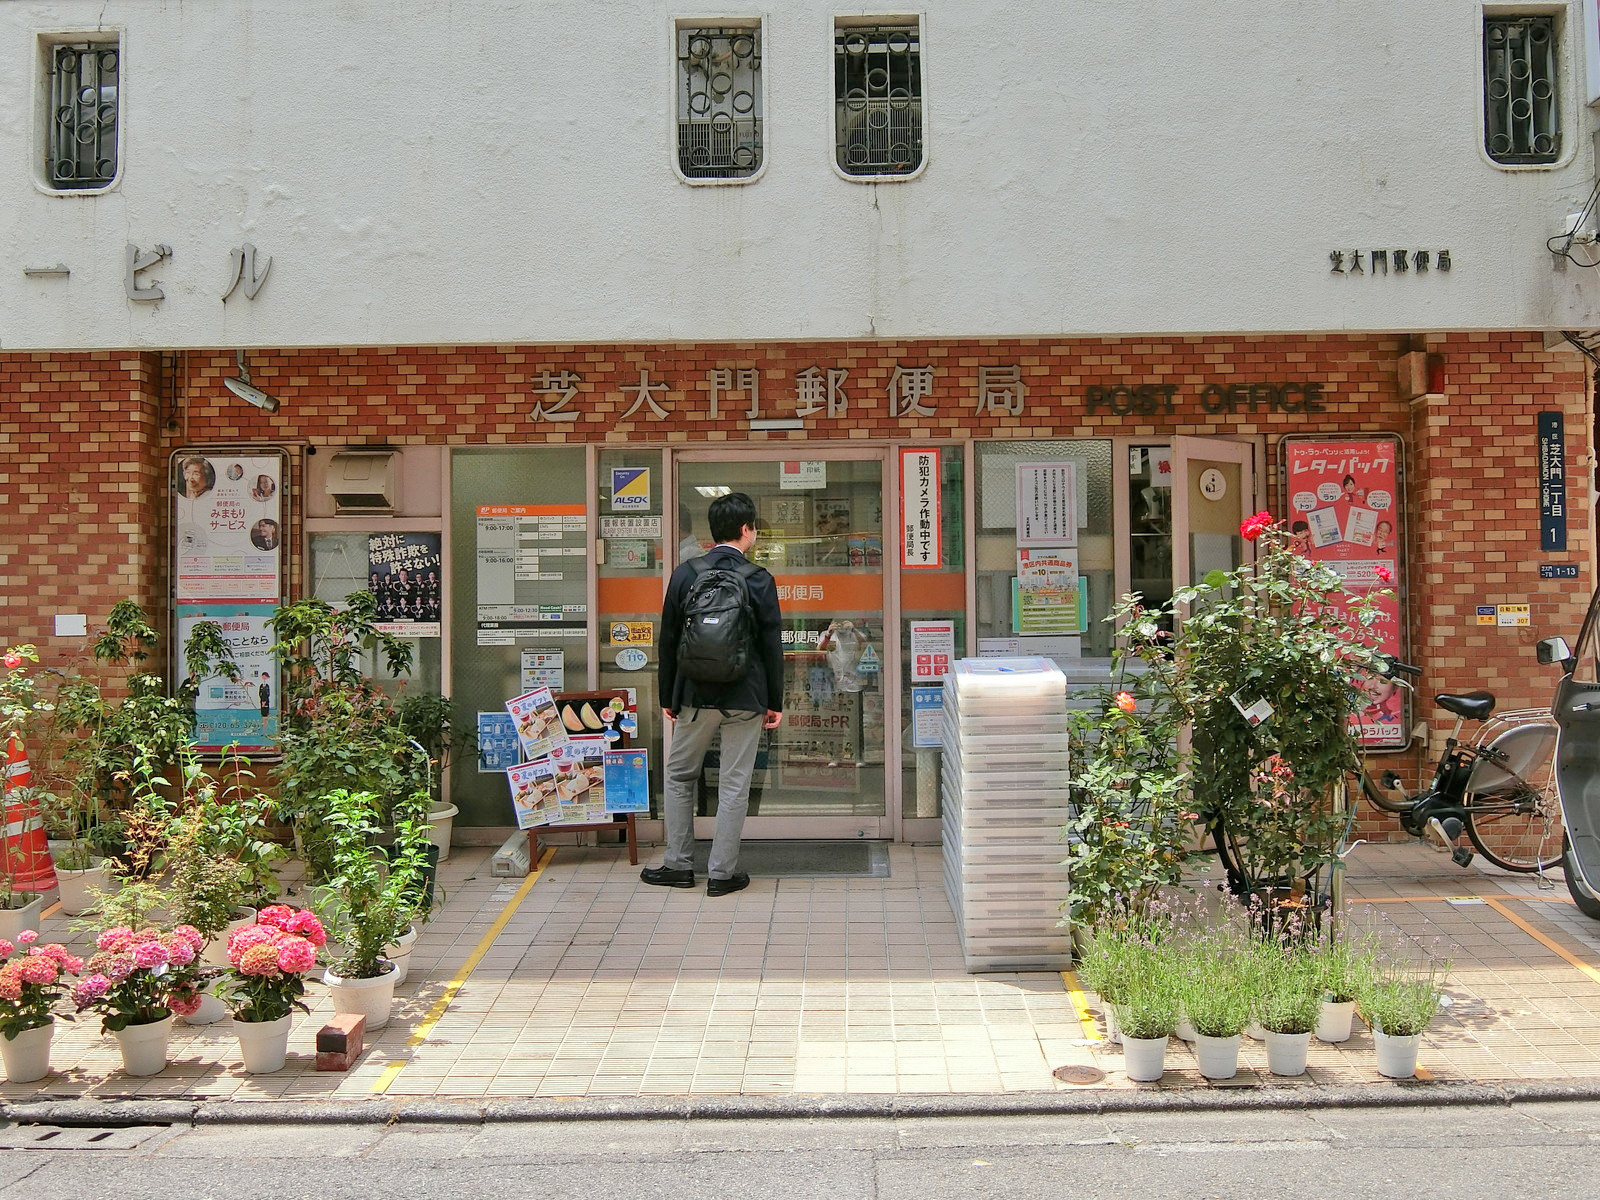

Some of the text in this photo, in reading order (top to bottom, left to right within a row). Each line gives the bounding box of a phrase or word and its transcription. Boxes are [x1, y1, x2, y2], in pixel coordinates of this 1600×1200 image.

[1329, 249, 1452, 274] 芝大門郵便局
[530, 364, 1026, 421] 芝大門郵便局
[1086, 383, 1326, 415] POST OFFICE
[1293, 457, 1389, 474] レターパック
[1550, 443, 1563, 516] 芝大門一丁目
[210, 509, 245, 519] みまもり
[919, 456, 930, 561] 防犯カメラ作動中です
[210, 520, 246, 530] サービス
[1550, 528, 1556, 542] 1
[369, 534, 405, 551] 絶対に
[906, 525, 914, 556] 郵便局長
[370, 544, 429, 565] 特殊詐欺を
[390, 554, 440, 575] 許さない!
[222, 622, 249, 631] 郵便局
[781, 631, 820, 644] 郵便局
